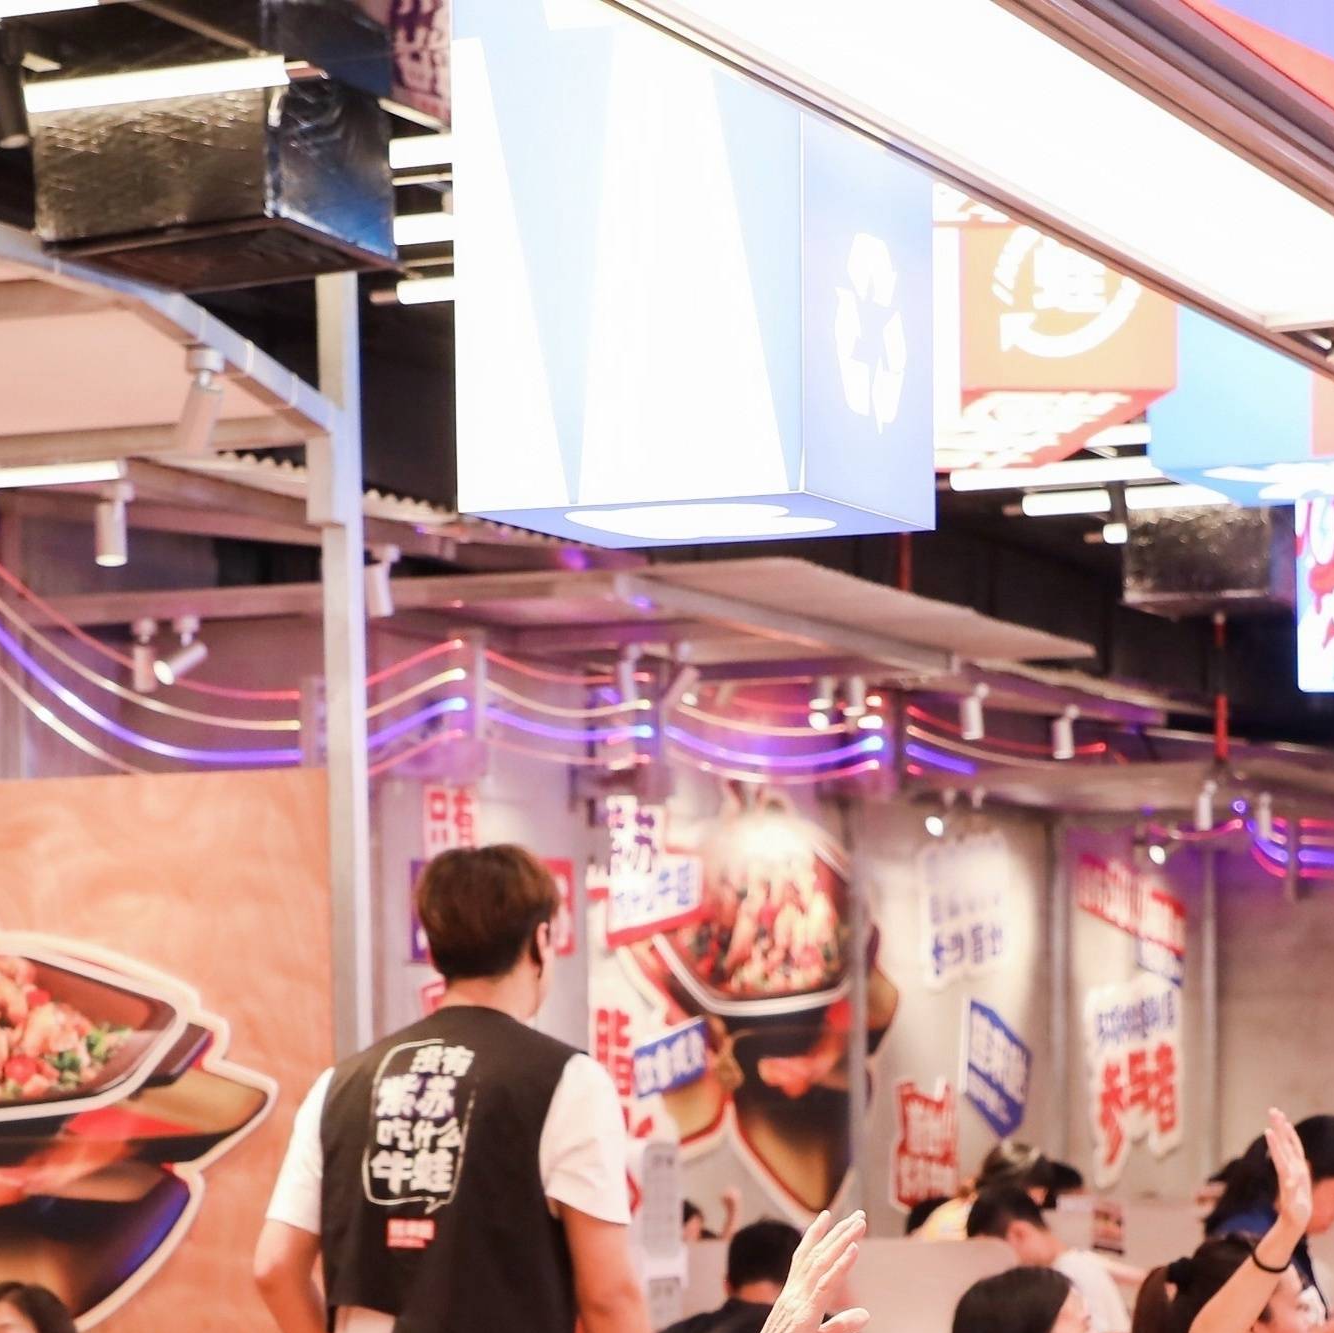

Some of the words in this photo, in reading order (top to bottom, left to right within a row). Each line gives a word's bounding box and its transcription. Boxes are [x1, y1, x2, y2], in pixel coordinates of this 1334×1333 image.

[410, 1045, 475, 1077] 没有
[376, 1073, 456, 1118] 紫苏
[376, 1117, 461, 1150] 吃什么
[370, 1149, 453, 1194] 牛蛙
